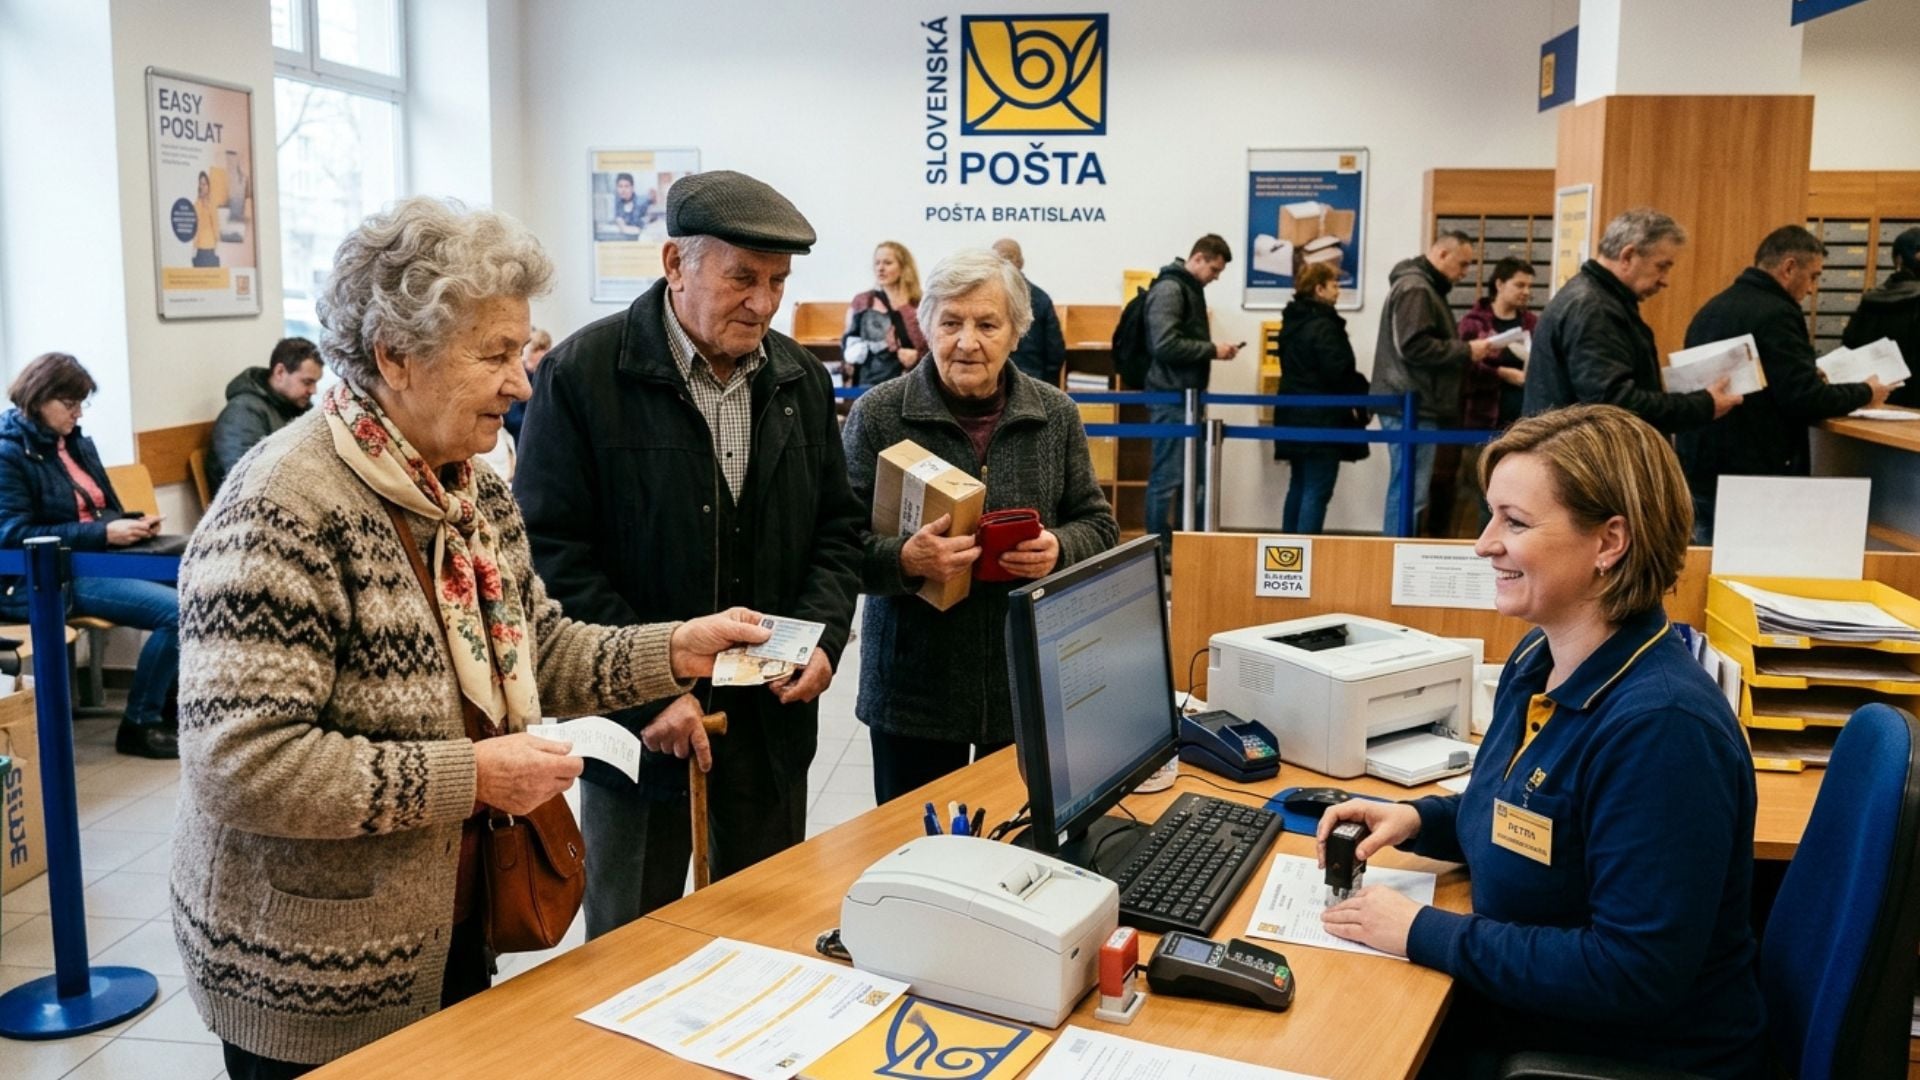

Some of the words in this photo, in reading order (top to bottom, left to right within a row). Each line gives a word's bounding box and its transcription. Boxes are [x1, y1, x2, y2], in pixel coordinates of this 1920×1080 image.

[159, 88, 203, 115] EASY
[920, 16, 948, 184] SLOVENSKÁ
[160, 115, 224, 144] POSLAT
[960, 142, 1107, 185] POŠTA
[926, 203, 986, 222] POŠTA
[992, 207, 1106, 222] BRATISLAVA
